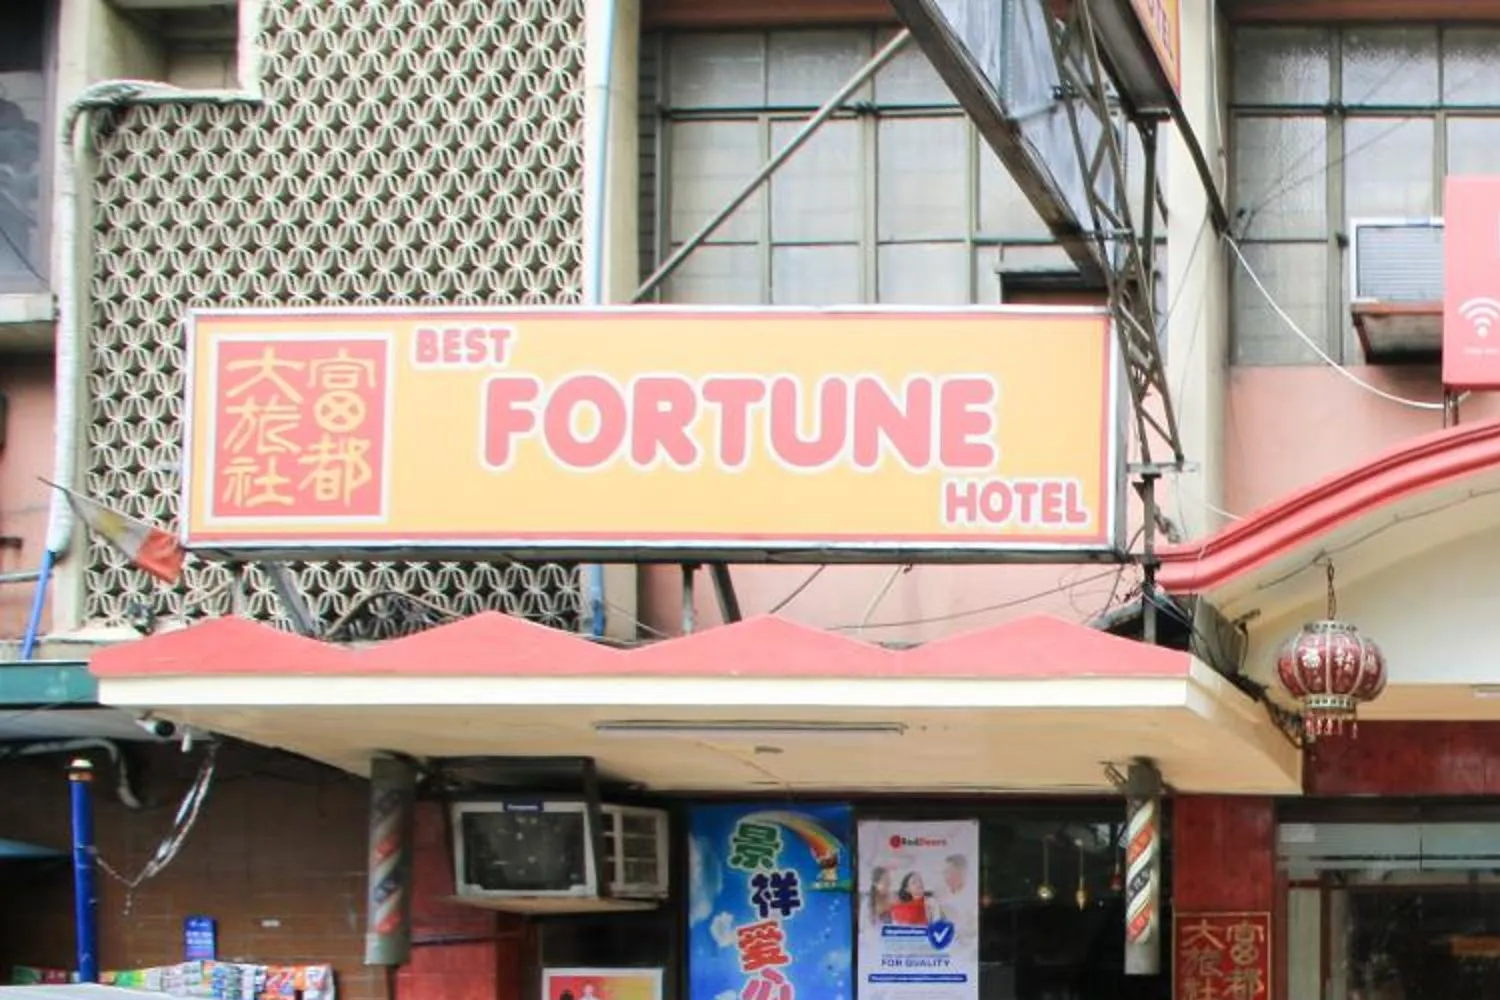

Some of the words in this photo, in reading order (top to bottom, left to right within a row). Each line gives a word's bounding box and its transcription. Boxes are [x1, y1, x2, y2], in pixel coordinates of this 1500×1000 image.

[415, 330, 511, 365] BEST
[483, 376, 997, 471] FORTUNE
[943, 480, 1087, 524] HOTEL
